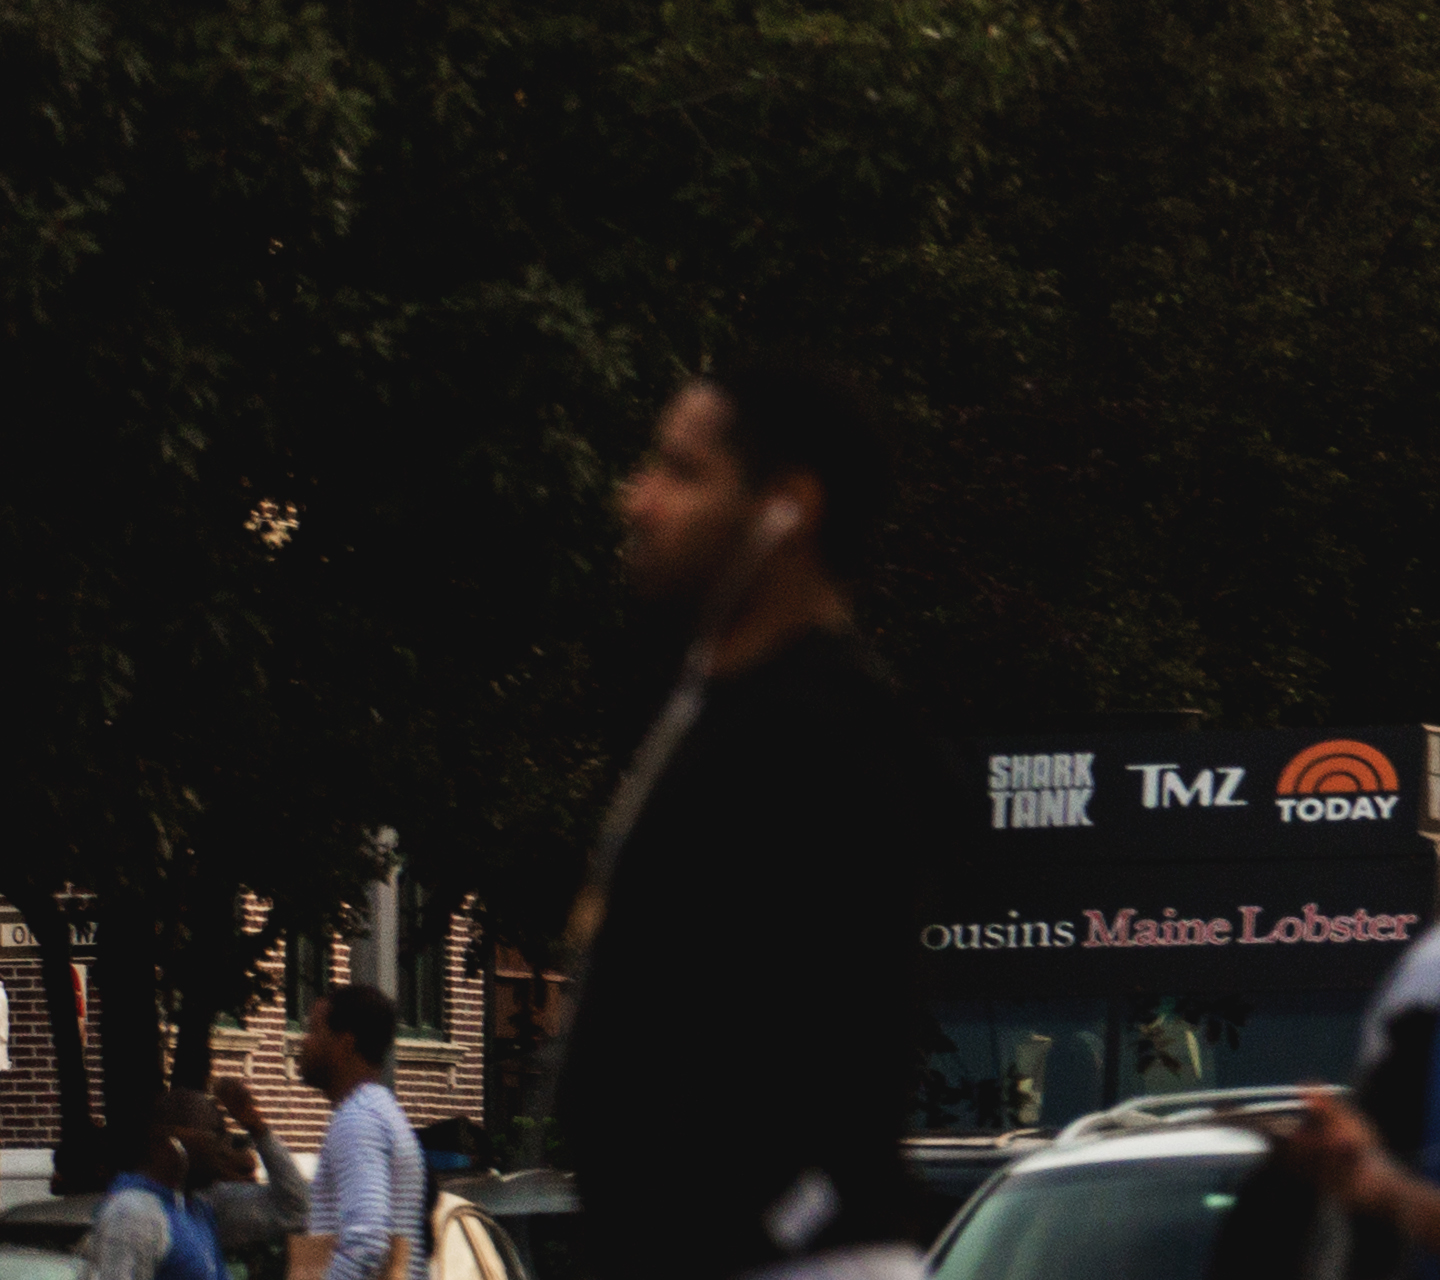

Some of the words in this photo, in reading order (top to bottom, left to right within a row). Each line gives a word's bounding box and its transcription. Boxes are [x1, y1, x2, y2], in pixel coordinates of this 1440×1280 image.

[988, 753, 1096, 788] SHARK
[1124, 763, 1249, 809] TMZ
[989, 789, 1094, 829] TANK
[1275, 794, 1399, 822] TODAY
[920, 910, 1076, 950] ousins
[1081, 907, 1232, 948] Maine
[1237, 903, 1418, 945] Lobster
